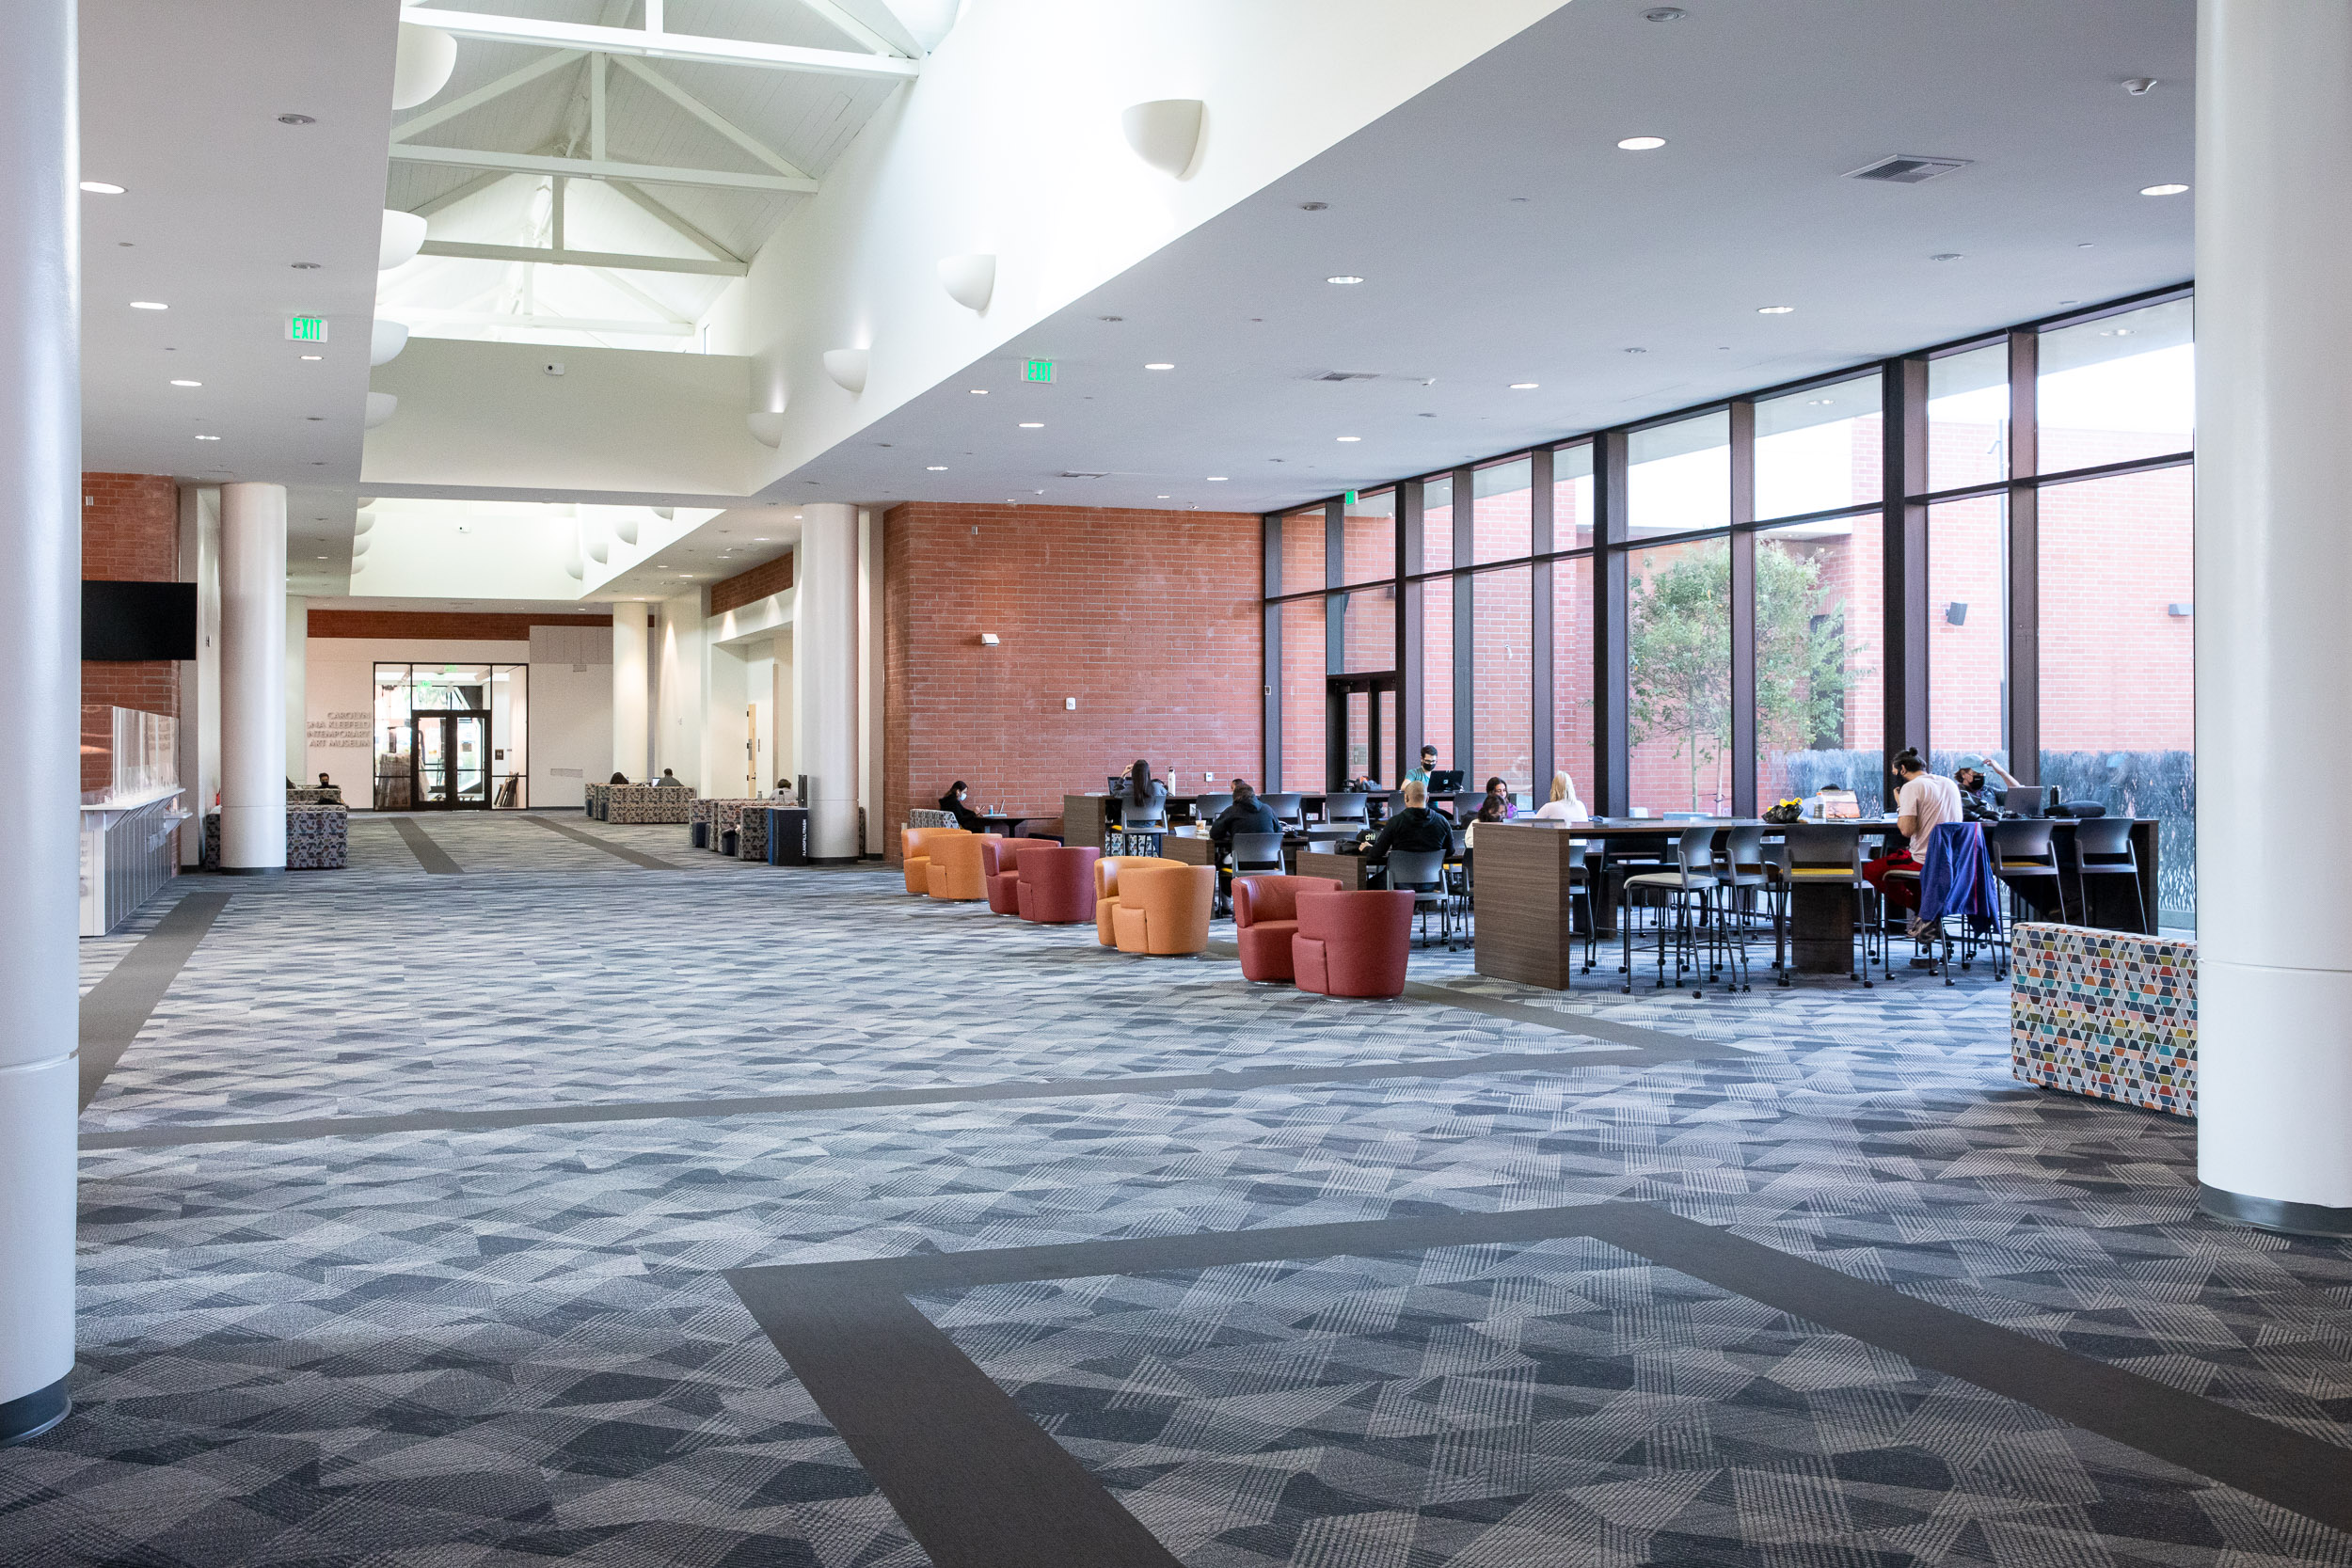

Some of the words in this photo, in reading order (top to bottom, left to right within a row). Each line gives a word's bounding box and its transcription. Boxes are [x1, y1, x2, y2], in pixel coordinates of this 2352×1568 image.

[293, 317, 322, 341] EXIT
[1028, 360, 1052, 382] EXIT
[328, 721, 371, 729] KLEEFELD
[309, 739, 326, 748] ART
[328, 739, 371, 748] MUSEUM
